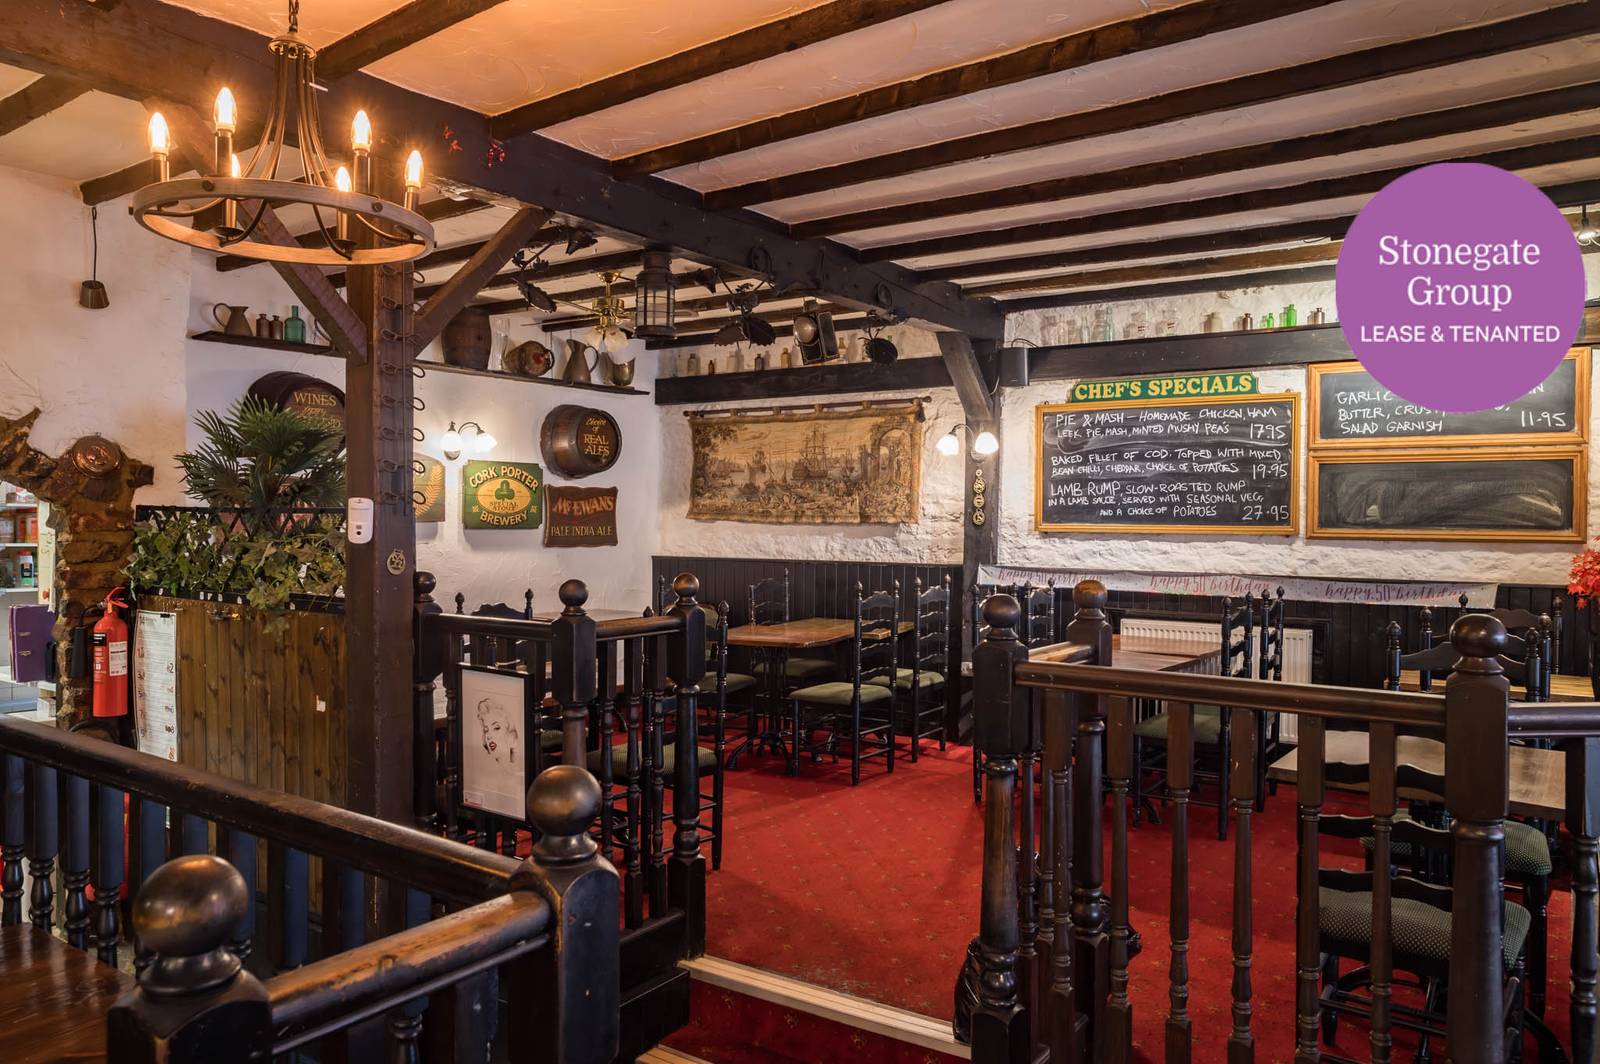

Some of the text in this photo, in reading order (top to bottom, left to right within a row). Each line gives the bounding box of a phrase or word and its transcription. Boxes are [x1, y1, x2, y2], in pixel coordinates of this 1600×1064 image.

[1075, 374, 1253, 401] CHEF'S SPECIALS
[294, 391, 337, 407] WINES
[1336, 391, 1394, 405] GARLIC
[1056, 414, 1077, 428] PIE
[1082, 414, 1092, 427] &
[1094, 411, 1125, 425] MASH
[1139, 410, 1191, 421] HOMEMADE
[1247, 406, 1277, 418] HAM
[1057, 429, 1082, 438] LEEK
[1132, 424, 1164, 435] MINTED
[1167, 422, 1200, 434] MUSHY
[1340, 422, 1379, 434] SALAD
[1386, 420, 1443, 432] GARNISH
[584, 433, 609, 445] REAL
[584, 445, 610, 456] ALES
[1051, 454, 1083, 466] BAKED
[1088, 452, 1118, 463] FILLET
[1123, 451, 1140, 461] OF
[1174, 448, 1212, 460] TOPPED
[1217, 448, 1245, 458] WITH
[1249, 449, 1281, 460] MIXED
[1051, 466, 1074, 477] BEAN
[1146, 462, 1176, 471] CHOICE
[1179, 462, 1189, 472] OF
[1193, 462, 1239, 473] POTATOES
[1252, 463, 1289, 480] 19.95
[469, 466, 539, 493] CORK PORTER
[1050, 482, 1082, 497] LAMB
[1216, 480, 1246, 492] RUMP
[1048, 498, 1058, 507] IN
[1068, 496, 1089, 505] LAMB
[1122, 496, 1156, 504] SERVED
[1160, 494, 1181, 502] WITH
[1187, 493, 1237, 504] SEASONAL
[480, 510, 528, 525] BREWERY
[1100, 505, 1289, 521] AND A CHOICE OF POTATOES 27.95
[551, 526, 612, 536] PALE INDIA ALE
[1151, 575, 1189, 590] happy
[1326, 583, 1371, 599] happy
